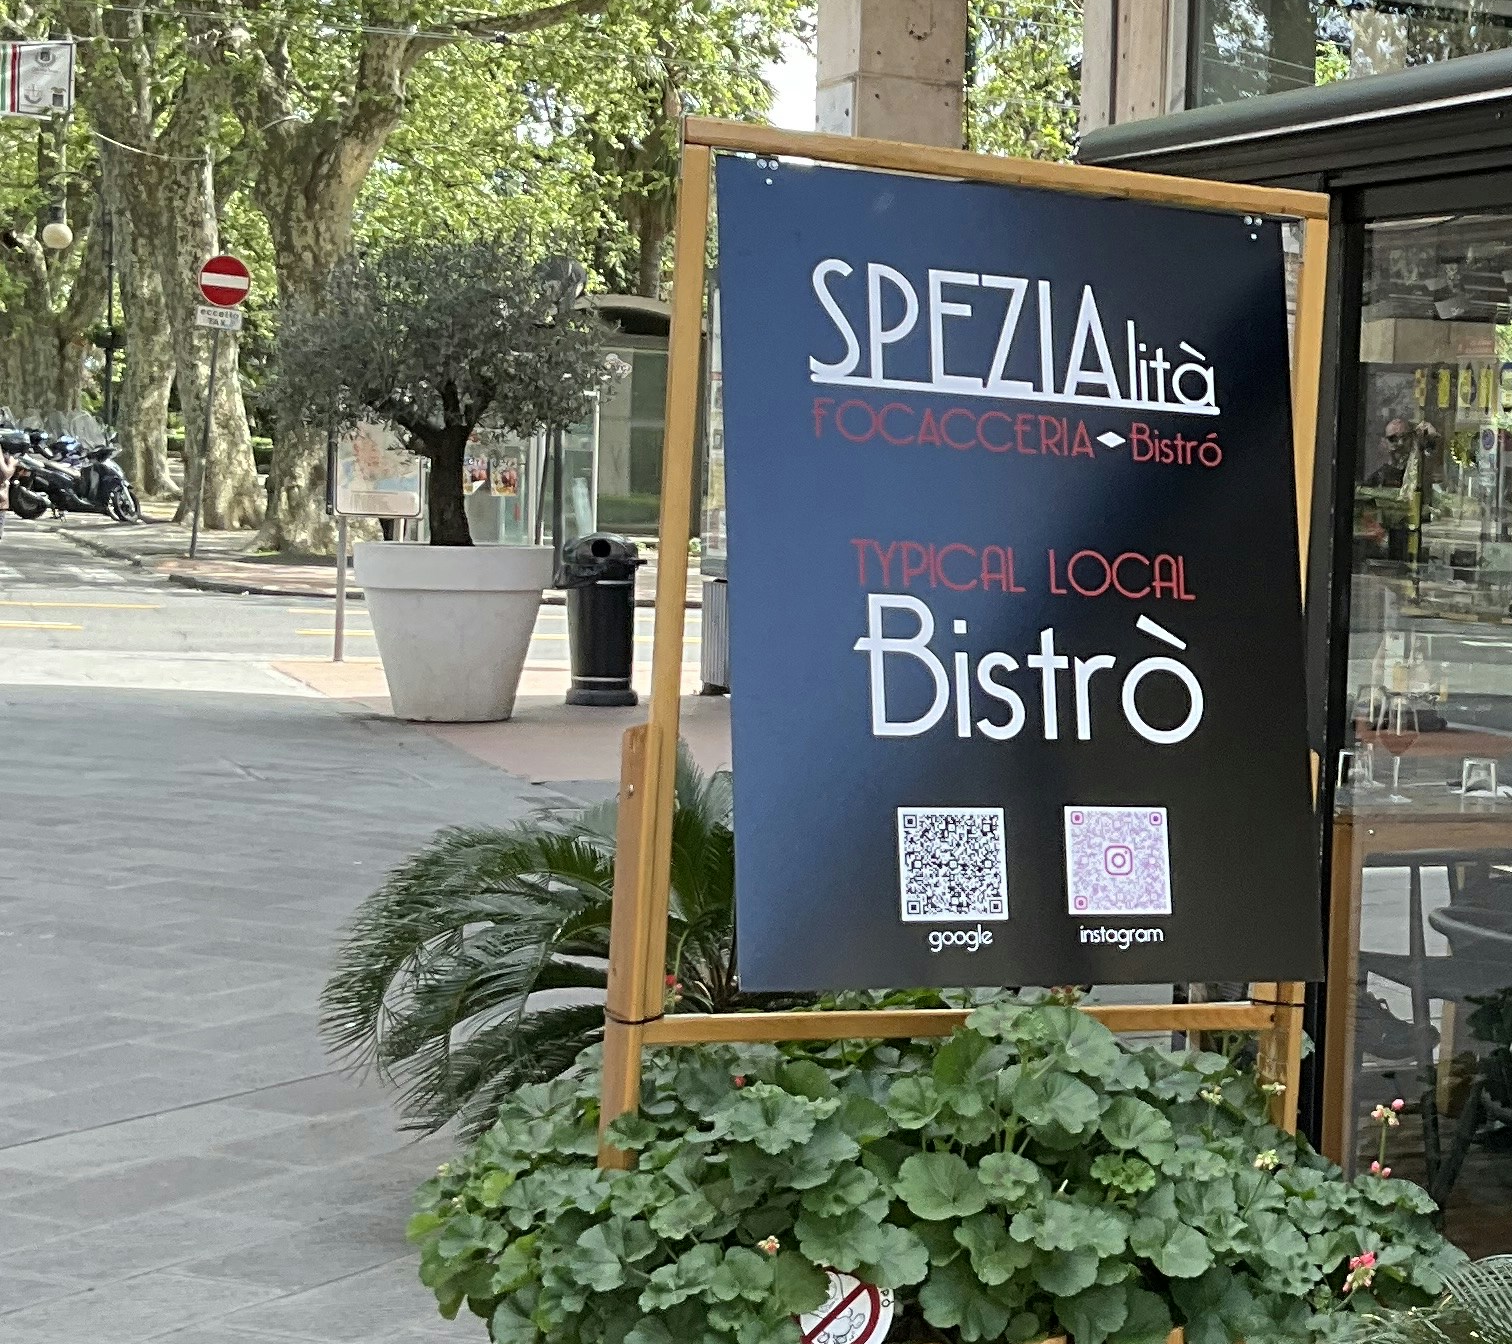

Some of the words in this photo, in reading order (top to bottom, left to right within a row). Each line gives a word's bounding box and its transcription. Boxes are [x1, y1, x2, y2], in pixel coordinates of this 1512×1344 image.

[809, 258, 1219, 414] SPEZIAlità
[812, 397, 1096, 458] FOCACCERIA
[850, 538, 1027, 593] TYPICAL
[1048, 548, 1197, 601] LOCAL
[853, 593, 1204, 744] Bistrò
[928, 924, 993, 953] google
[1079, 925, 1164, 950] instagram
